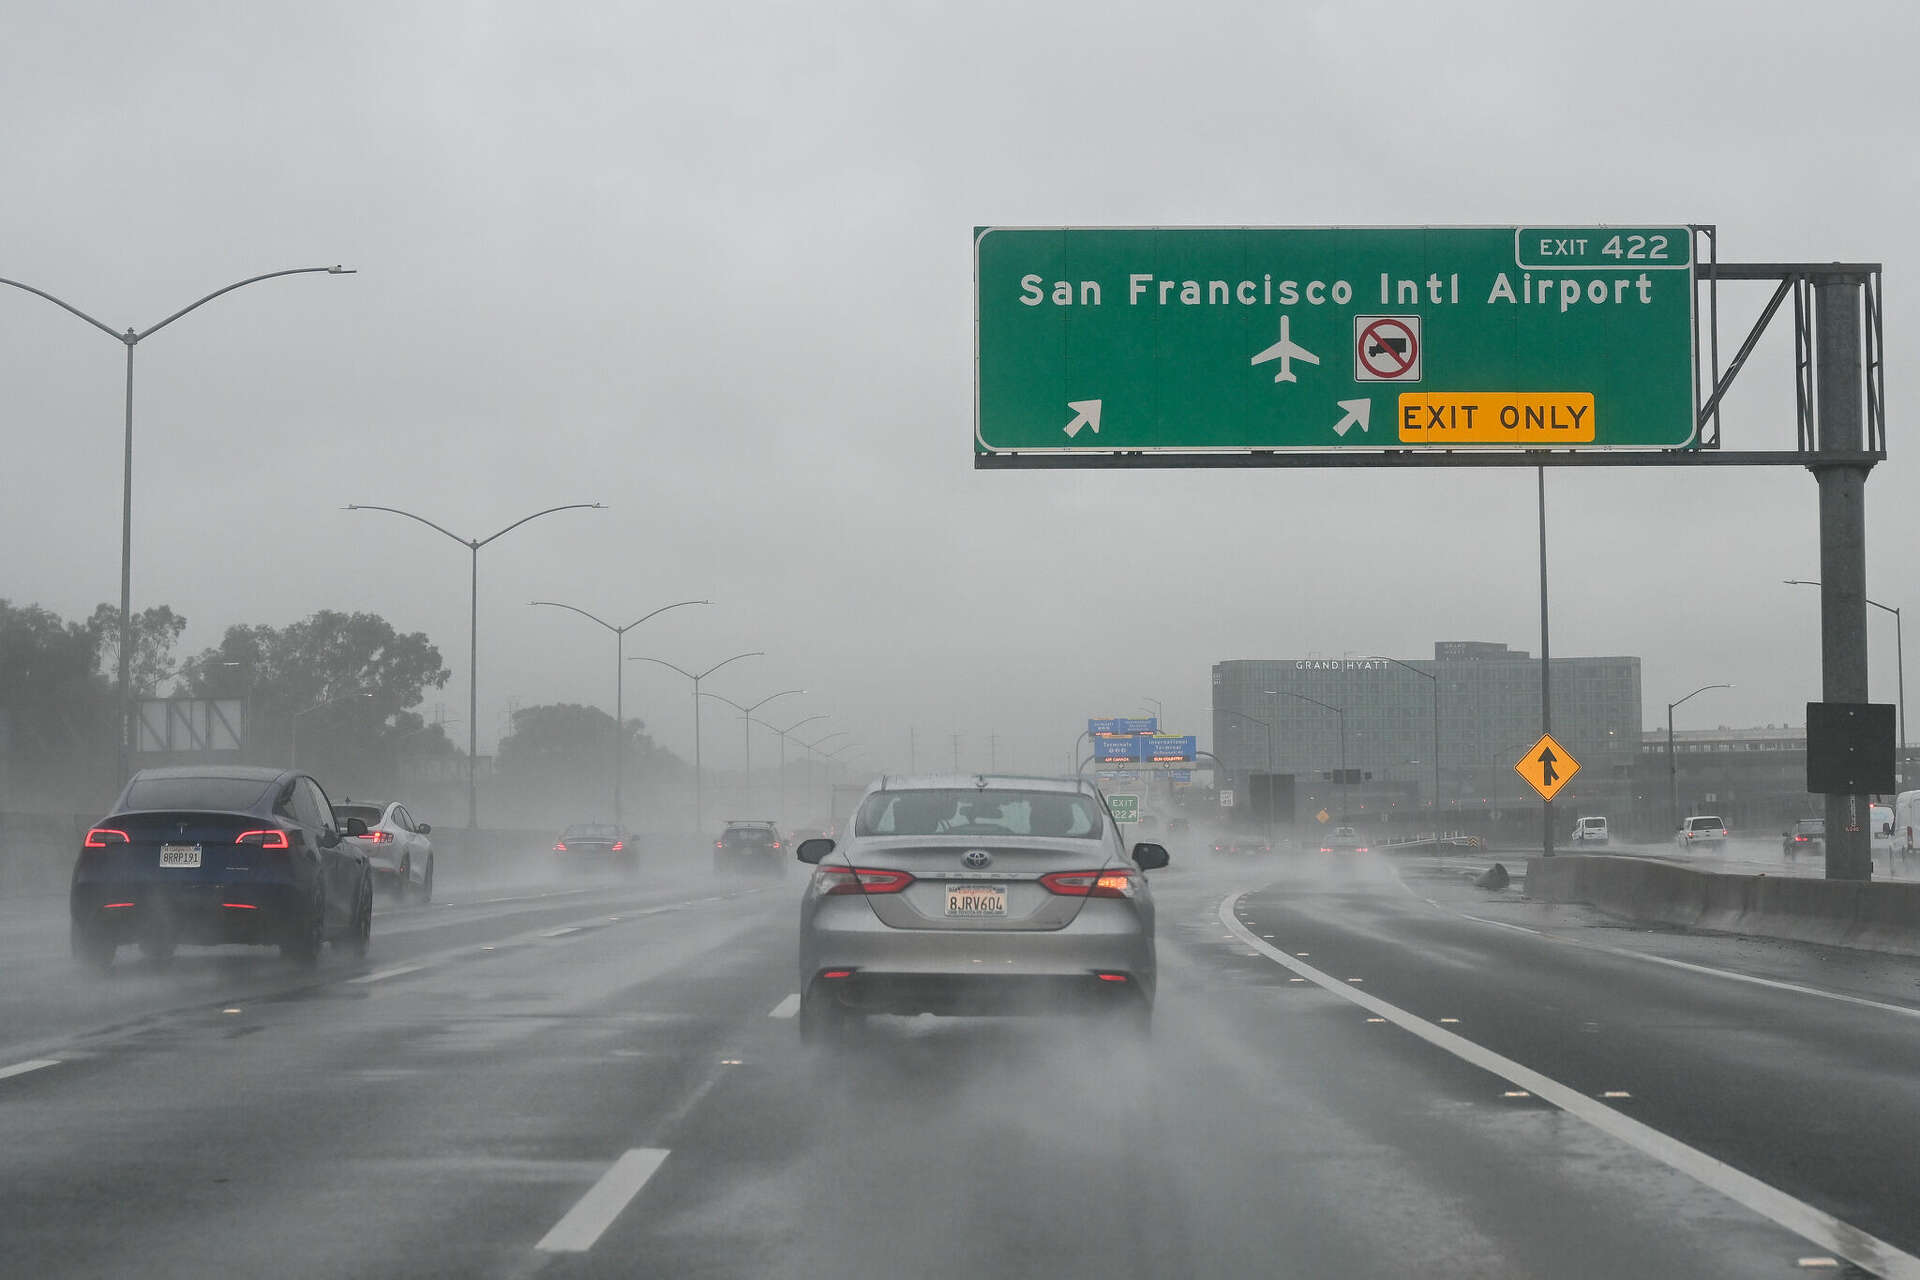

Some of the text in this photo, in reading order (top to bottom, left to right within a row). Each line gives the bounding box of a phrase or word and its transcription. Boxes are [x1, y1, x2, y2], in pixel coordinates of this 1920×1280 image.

[1540, 235, 1668, 259] EXIT 422
[1019, 272, 1652, 312] San Francisco Intl Airport
[1404, 405, 1588, 430] EXIT ONLY
[1295, 660, 1390, 670] GRAND HYATT
[1112, 799, 1134, 807] EXIT
[949, 896, 1003, 911] 8JRV604
